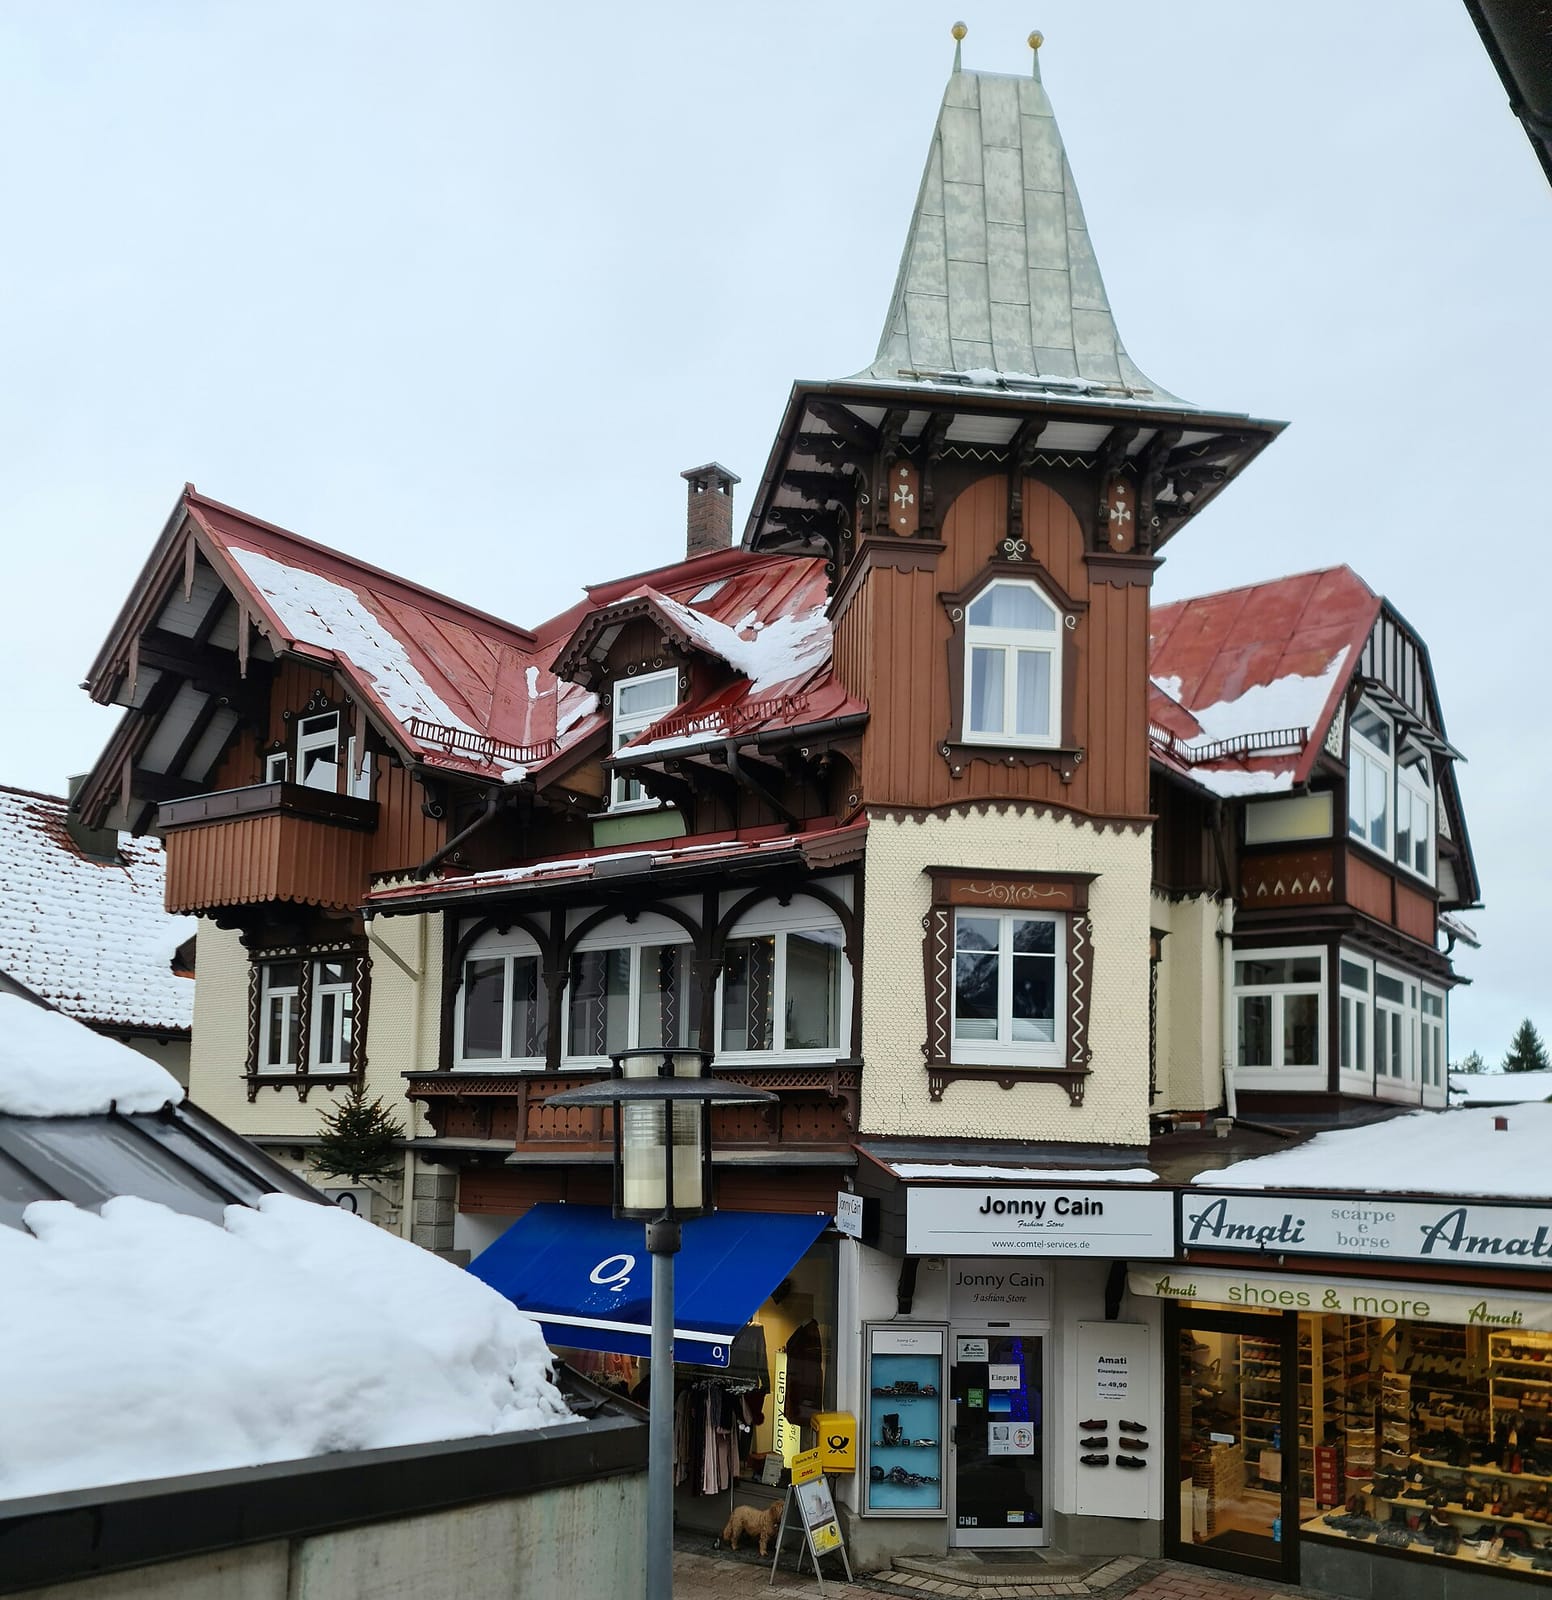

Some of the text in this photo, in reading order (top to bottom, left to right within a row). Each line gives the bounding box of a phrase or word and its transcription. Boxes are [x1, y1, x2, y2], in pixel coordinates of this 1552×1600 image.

[980, 1195, 1104, 1219] Jonny Cain
[1331, 1208, 1396, 1225] scarpe
[1017, 1219, 1065, 1228] Fashion Store
[1188, 1198, 1305, 1244] Amati
[1358, 1223, 1369, 1234] e
[1337, 1231, 1390, 1249] borse
[1420, 1207, 1552, 1258] Amat
[991, 1240, 1090, 1249] www.comtel-services.de
[955, 1271, 1044, 1290] Jonny Cain
[1155, 1275, 1198, 1297] Amati
[1228, 1283, 1430, 1317] shoes & more
[1468, 1300, 1524, 1325] Amati
[1098, 1356, 1127, 1364] Amati
[776, 1370, 786, 1405] Cain
[991, 1374, 1018, 1382] Eingang
